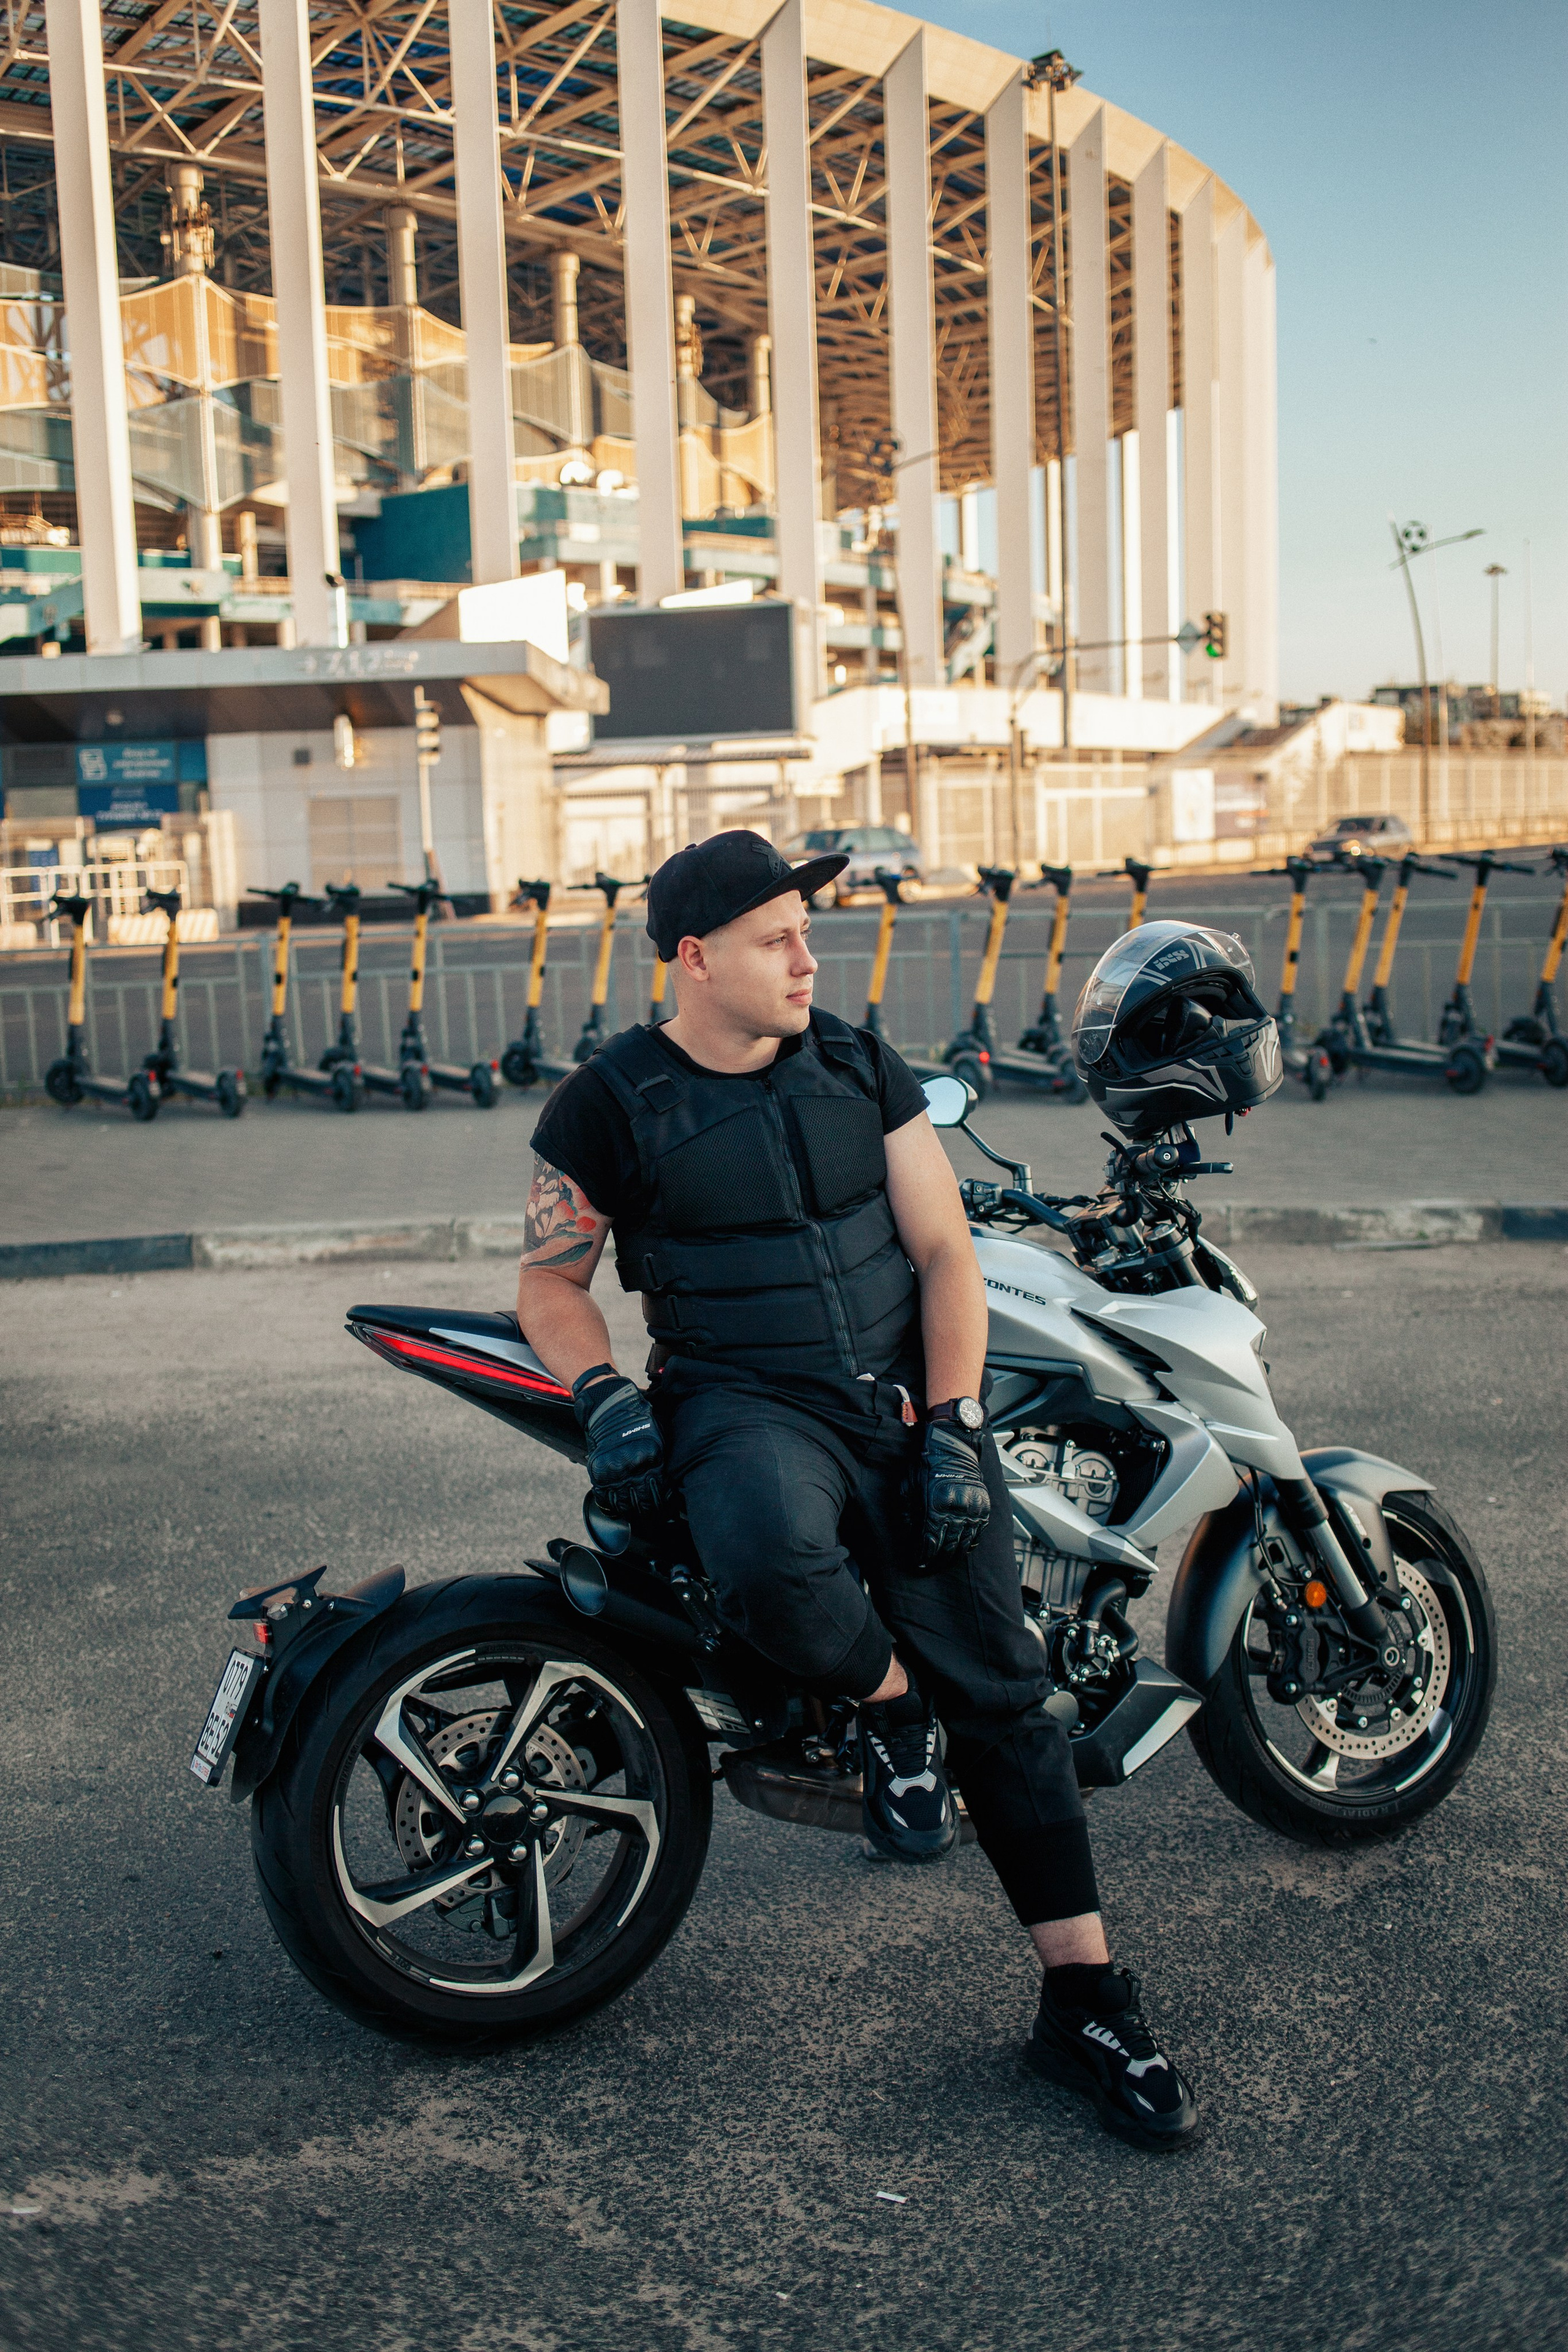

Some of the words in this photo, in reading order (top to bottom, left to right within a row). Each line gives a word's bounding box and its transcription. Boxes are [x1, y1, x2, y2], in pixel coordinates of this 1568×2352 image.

[622, 1423, 650, 1438] SHIMA
[223, 1659, 249, 1700] 0779
[1341, 1806, 1389, 1818] RADIAL
